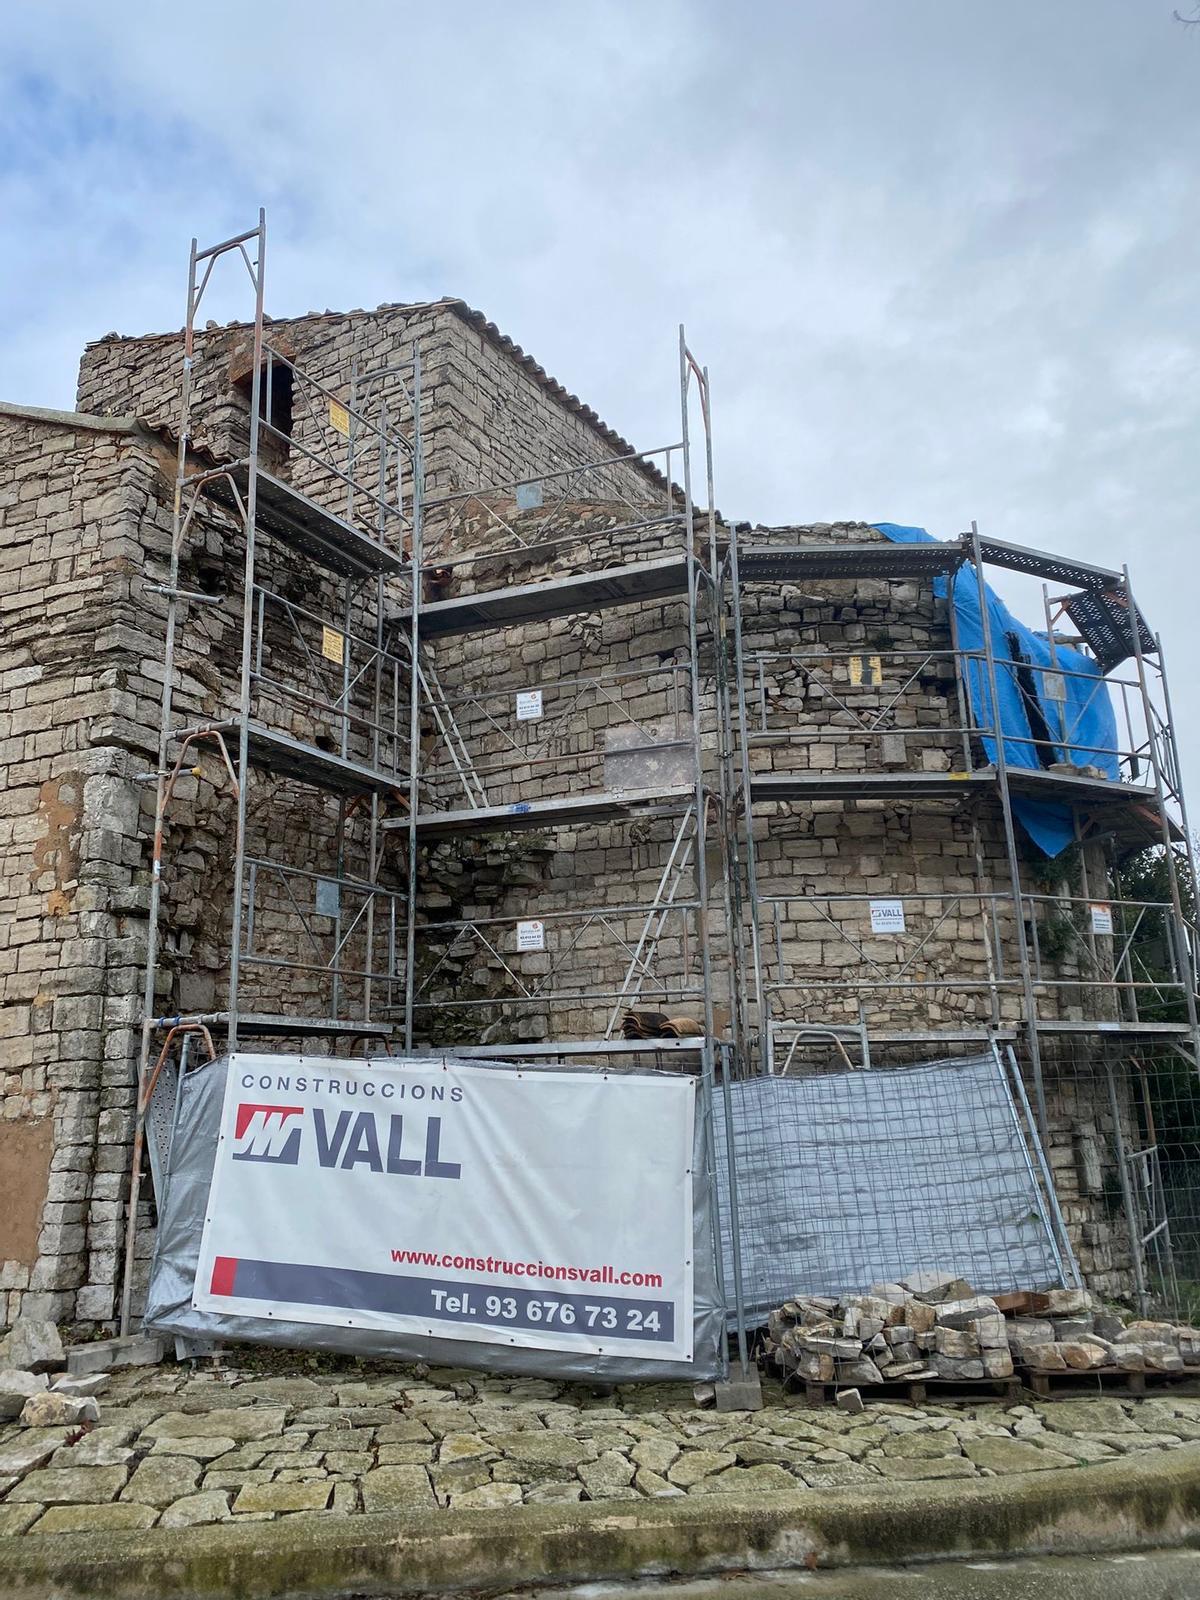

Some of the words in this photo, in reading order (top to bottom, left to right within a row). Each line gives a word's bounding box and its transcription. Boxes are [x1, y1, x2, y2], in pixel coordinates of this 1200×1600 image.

[881, 909, 902, 917] VALL
[241, 1074, 464, 1102] CONSTRUCCIONS
[312, 1108, 462, 1180] VALL
[391, 1249, 663, 1288] www.construccionsvall.com
[430, 1289, 476, 1315] Tel.
[485, 1295, 518, 1319] 93
[526, 1300, 576, 1325] 676
[584, 1305, 618, 1329] 73
[626, 1309, 661, 1333] 24
